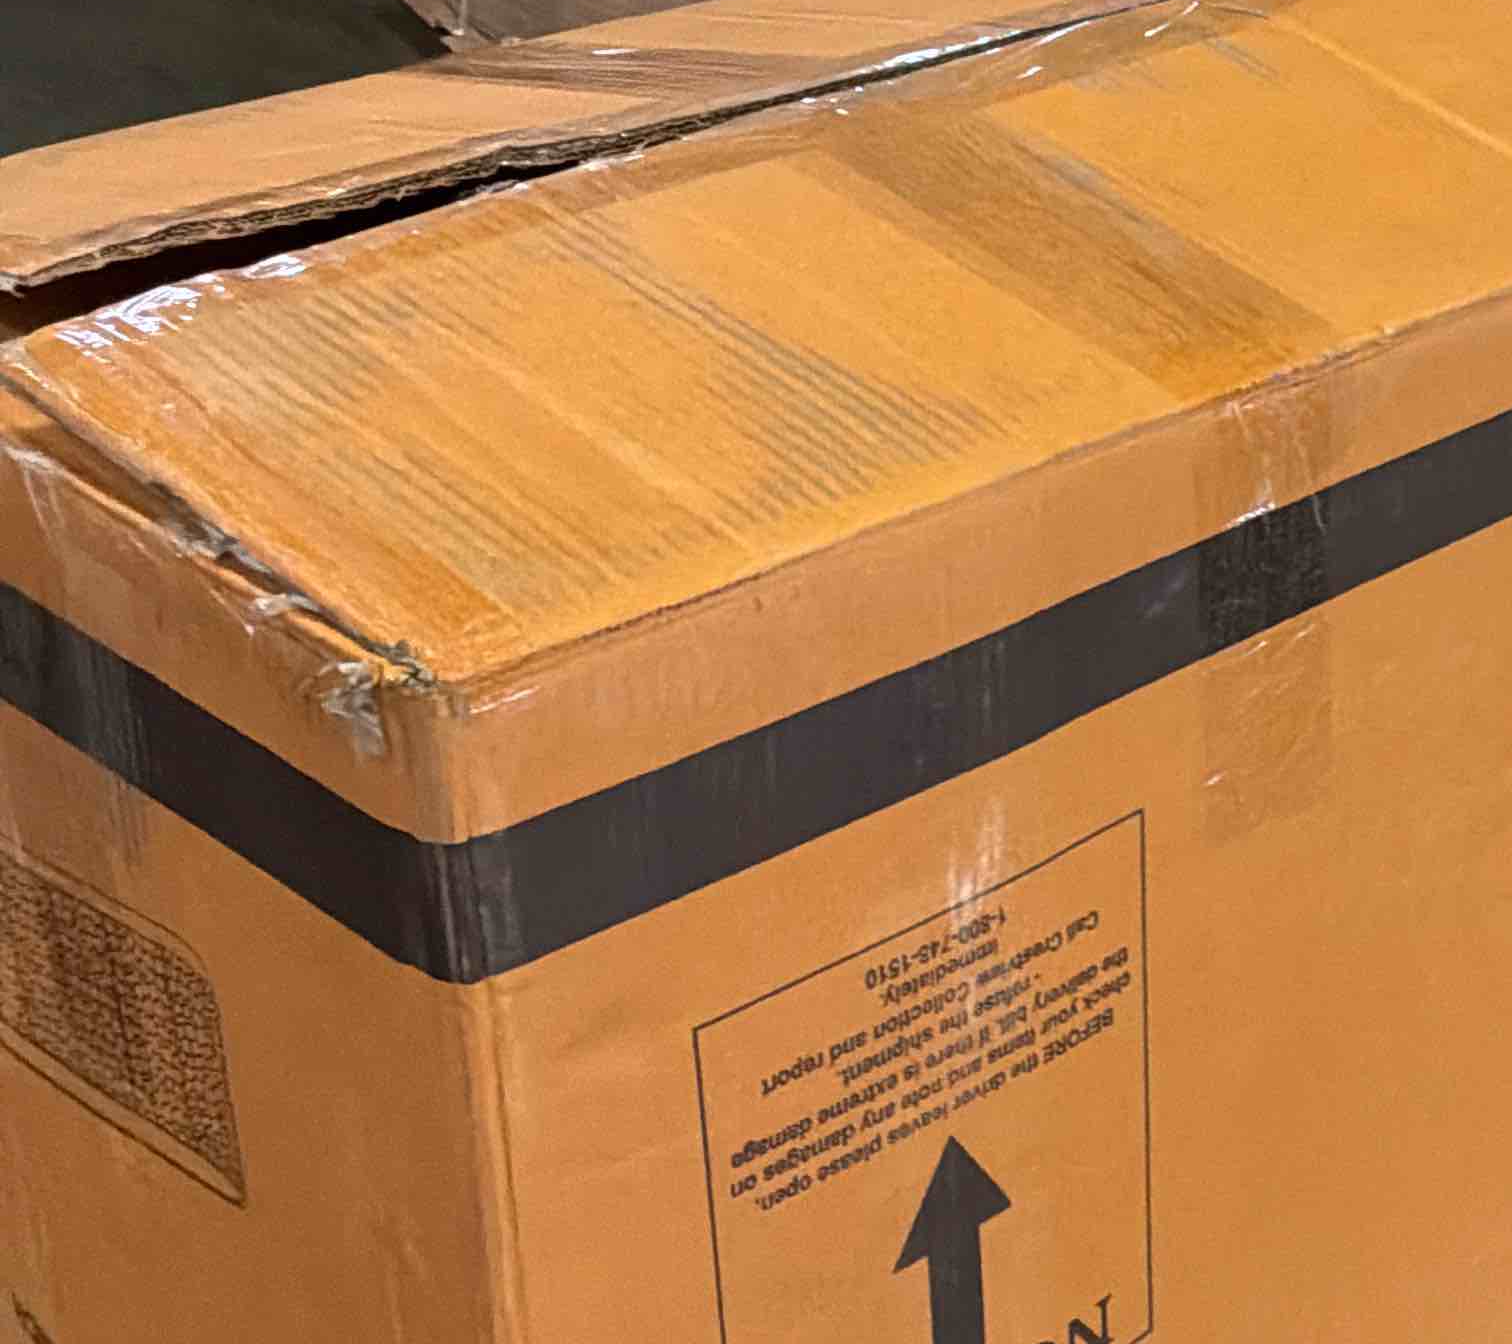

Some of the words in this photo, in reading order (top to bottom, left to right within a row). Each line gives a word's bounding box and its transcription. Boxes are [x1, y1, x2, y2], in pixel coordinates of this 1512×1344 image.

[1065, 909, 1100, 941] Call
[974, 929, 1064, 988] Crestview
[1101, 946, 1129, 973] the
[973, 976, 1032, 1018] refuse
[1032, 964, 1099, 1013] delivery
[1082, 971, 1131, 1010] check
[873, 981, 969, 1040] Collection
[939, 1009, 969, 1035] the
[1039, 996, 1080, 1035] your
[828, 1031, 868, 1067] and
[925, 1034, 974, 1071] there
[1041, 1007, 1115, 1065] BEFORE
[760, 1051, 825, 1098] report
[903, 1064, 920, 1083] is
[946, 1056, 983, 1087] and
[1010, 1051, 1040, 1079] the
[816, 1073, 898, 1126] extreme
[900, 1076, 943, 1109] note
[952, 1071, 1007, 1112] driver
[859, 1102, 897, 1133] any
[886, 1102, 949, 1144] leaves
[730, 1117, 813, 1169] damage
[762, 1124, 857, 1182] damages
[816, 1136, 882, 1181] please
[729, 1173, 758, 1199] on
